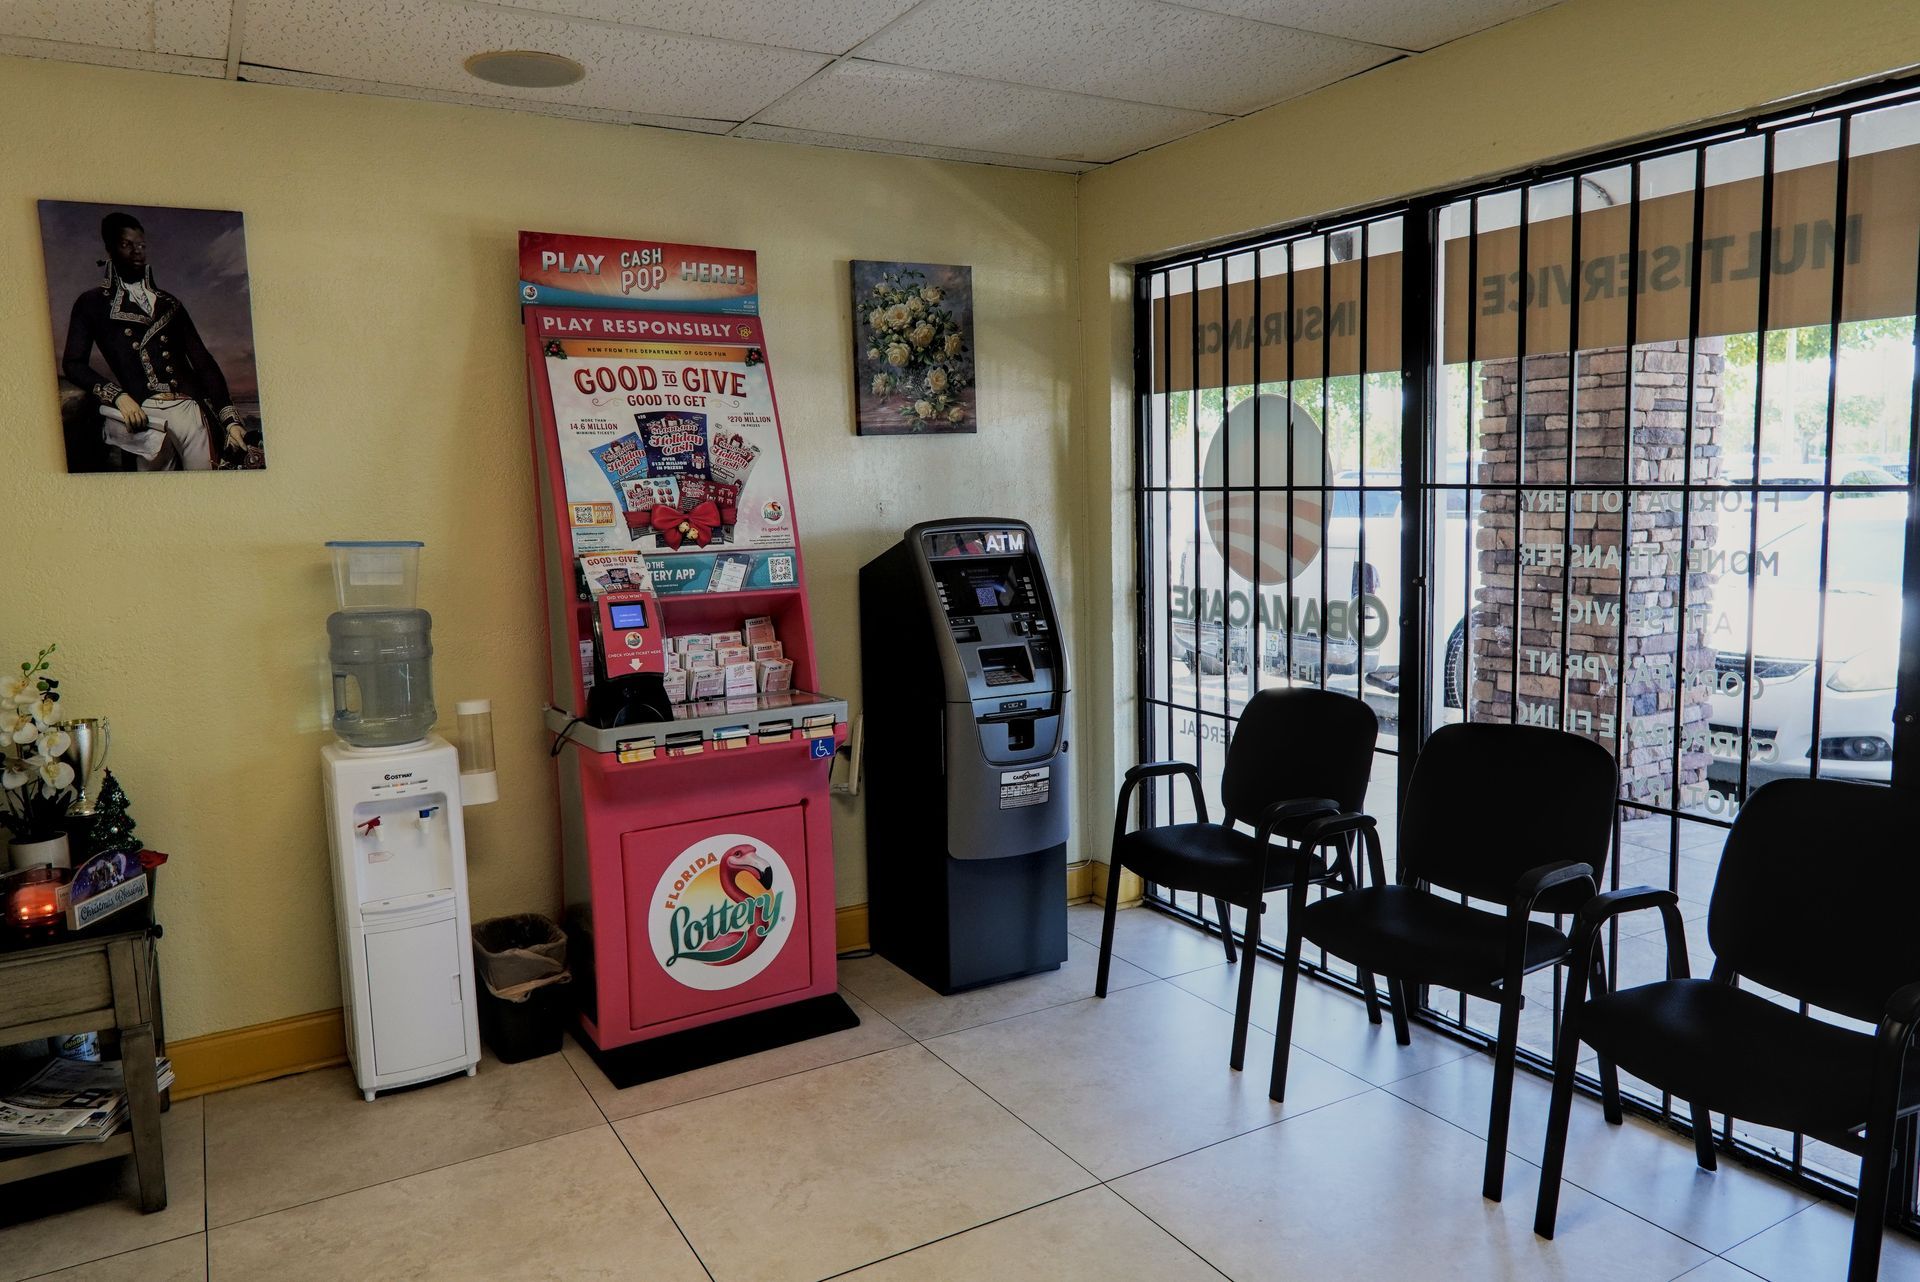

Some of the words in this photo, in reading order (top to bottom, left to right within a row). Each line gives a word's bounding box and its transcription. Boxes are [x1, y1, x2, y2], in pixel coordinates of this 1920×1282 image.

[542, 250, 605, 275] PLAY
[620, 247, 662, 267] CASH
[621, 265, 666, 295] POP
[680, 261, 745, 285] HERE!
[543, 316, 593, 332] PLAY
[602, 318, 731, 337] RESPONSIBLY
[574, 365, 658, 395] GOOD
[664, 371, 677, 385] TO
[682, 367, 747, 397] GIVE
[627, 394, 662, 407] GOOD
[666, 395, 680, 407] TO
[683, 395, 707, 408] GET
[570, 423, 586, 431] 14.6
[662, 441, 694, 456] Cash
[986, 534, 1024, 552] ATM
[587, 556, 612, 567] GOOD
[652, 561, 664, 569] THE
[676, 568, 696, 581] APP
[384, 772, 412, 780] COSTWAY
[665, 852, 719, 909] FLORIDA
[80, 898, 115, 921] Christmas
[666, 891, 784, 967] Lottery
